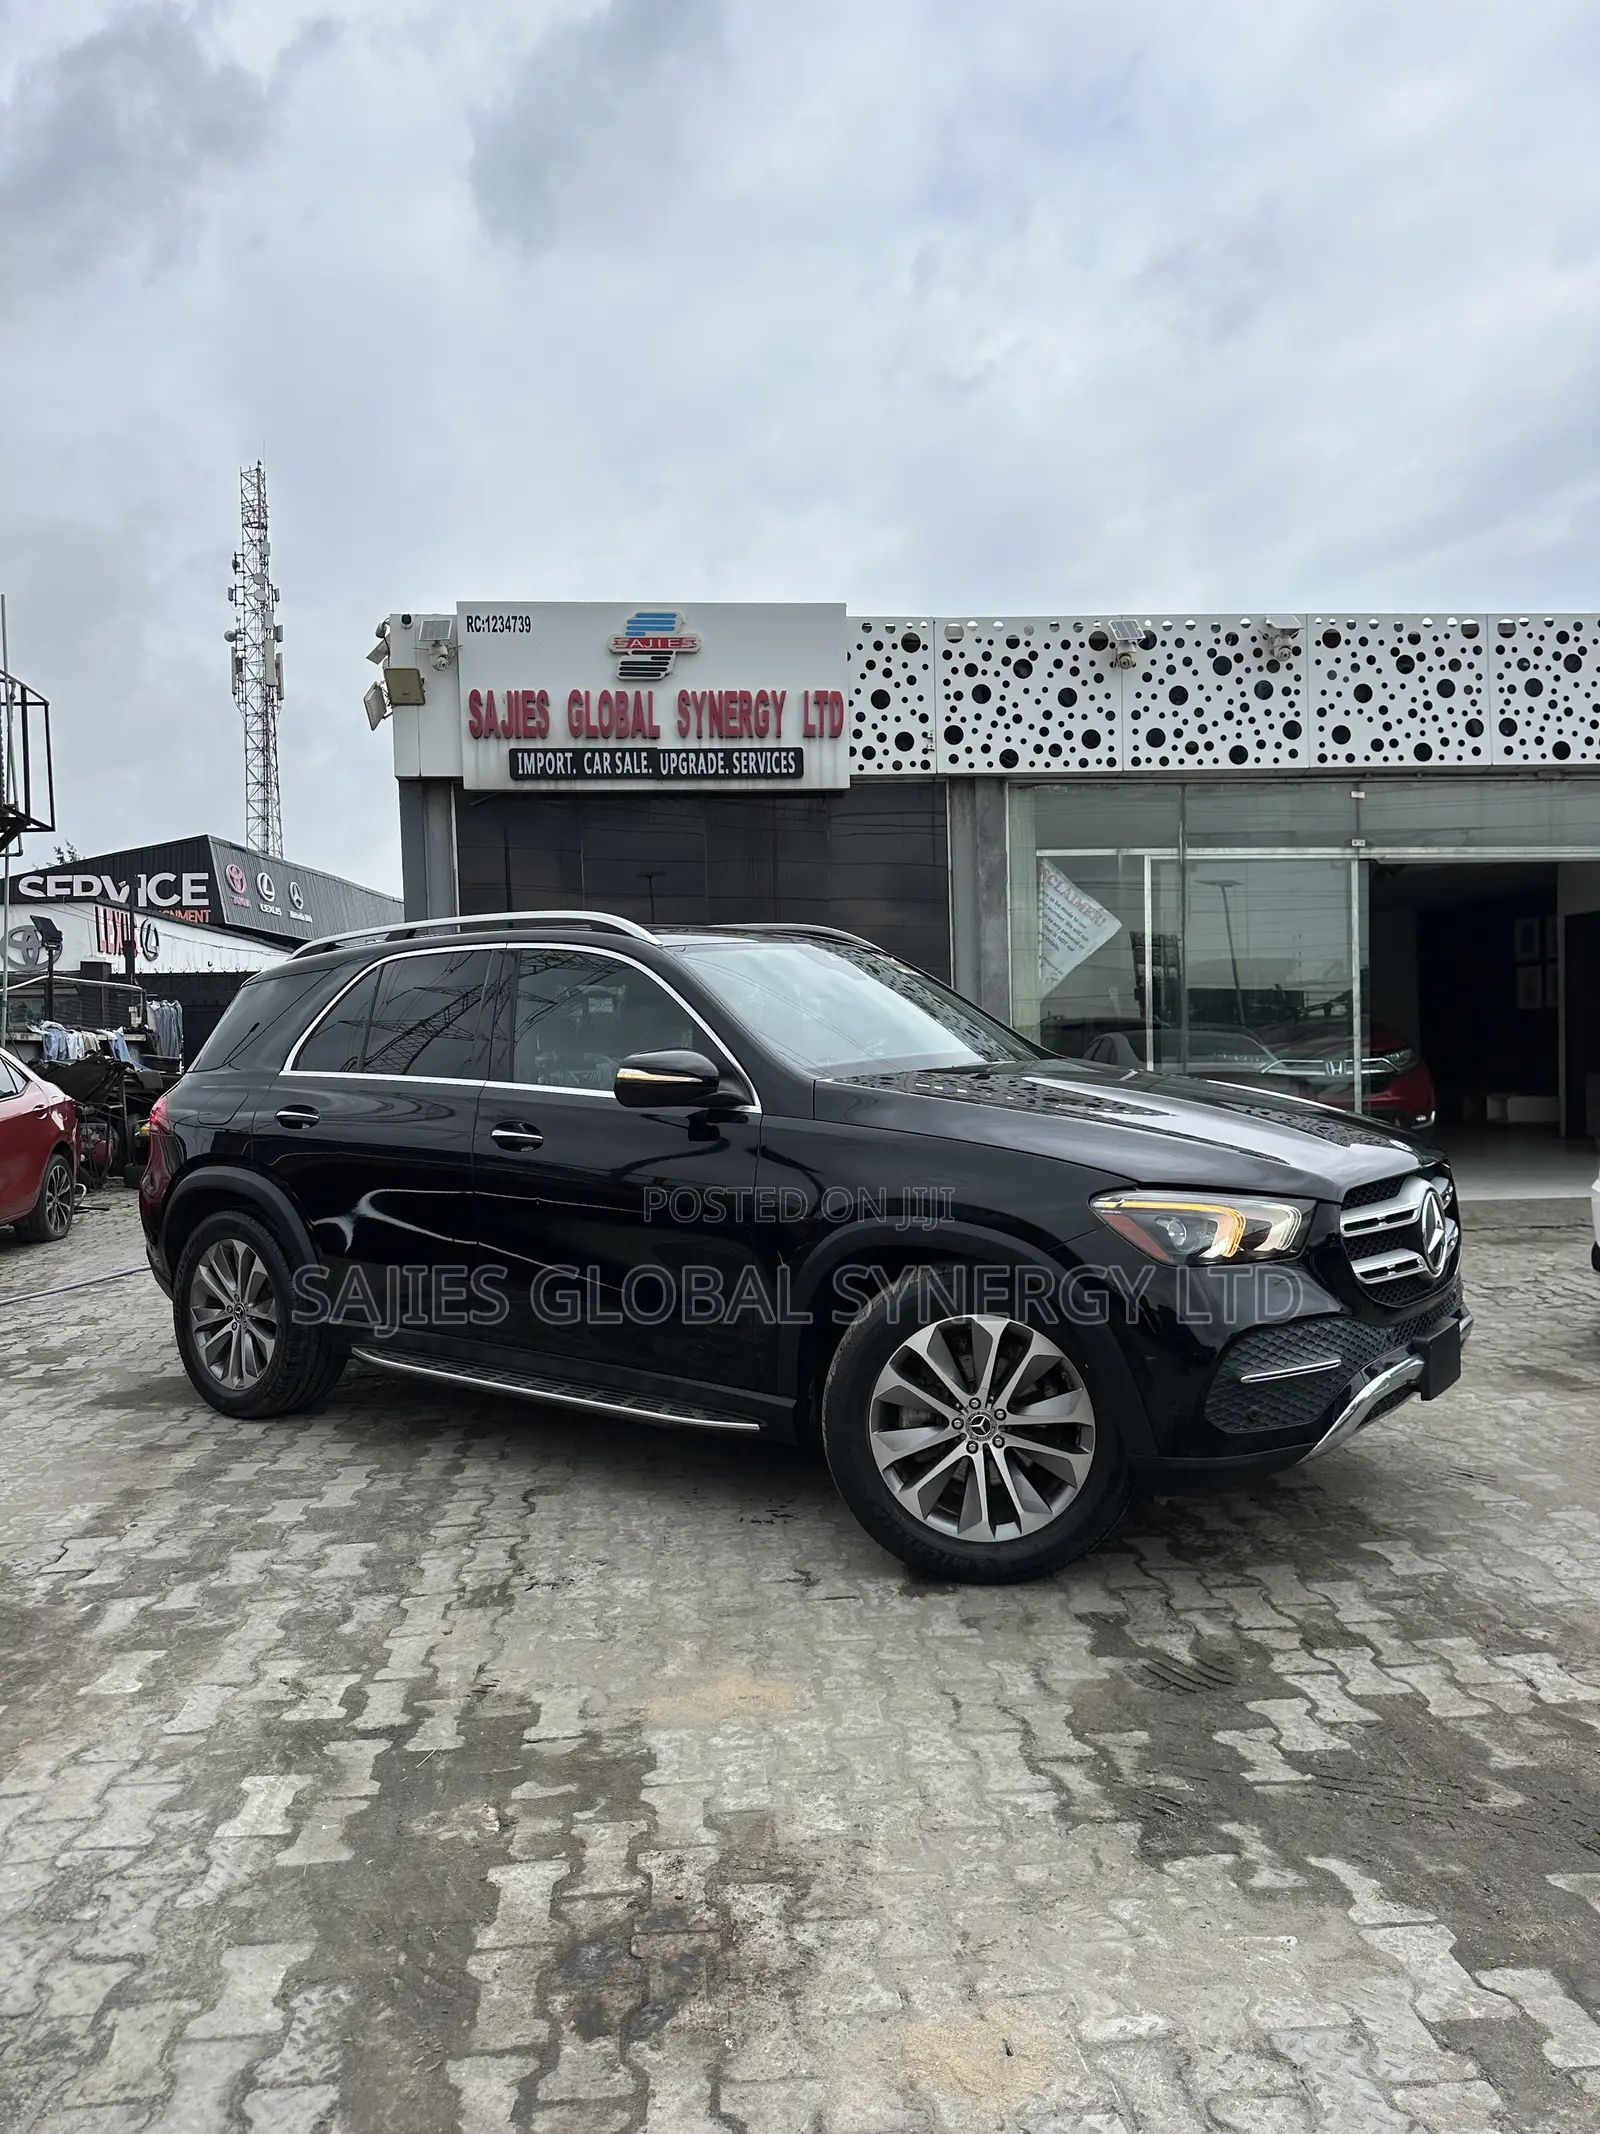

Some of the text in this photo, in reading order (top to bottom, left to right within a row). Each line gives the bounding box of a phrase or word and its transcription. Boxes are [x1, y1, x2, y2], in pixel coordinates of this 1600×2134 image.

[466, 615, 532, 633] RC:1234739
[614, 638, 697, 648] SAJIES
[468, 688, 844, 740] SAJIES GLOBAL SYNERGY LTD
[517, 751, 796, 775] IMPORT. CAR SALE. UPGRADE. SERVICES
[18, 872, 210, 907] SERVICE
[259, 903, 283, 917] LEXUS
